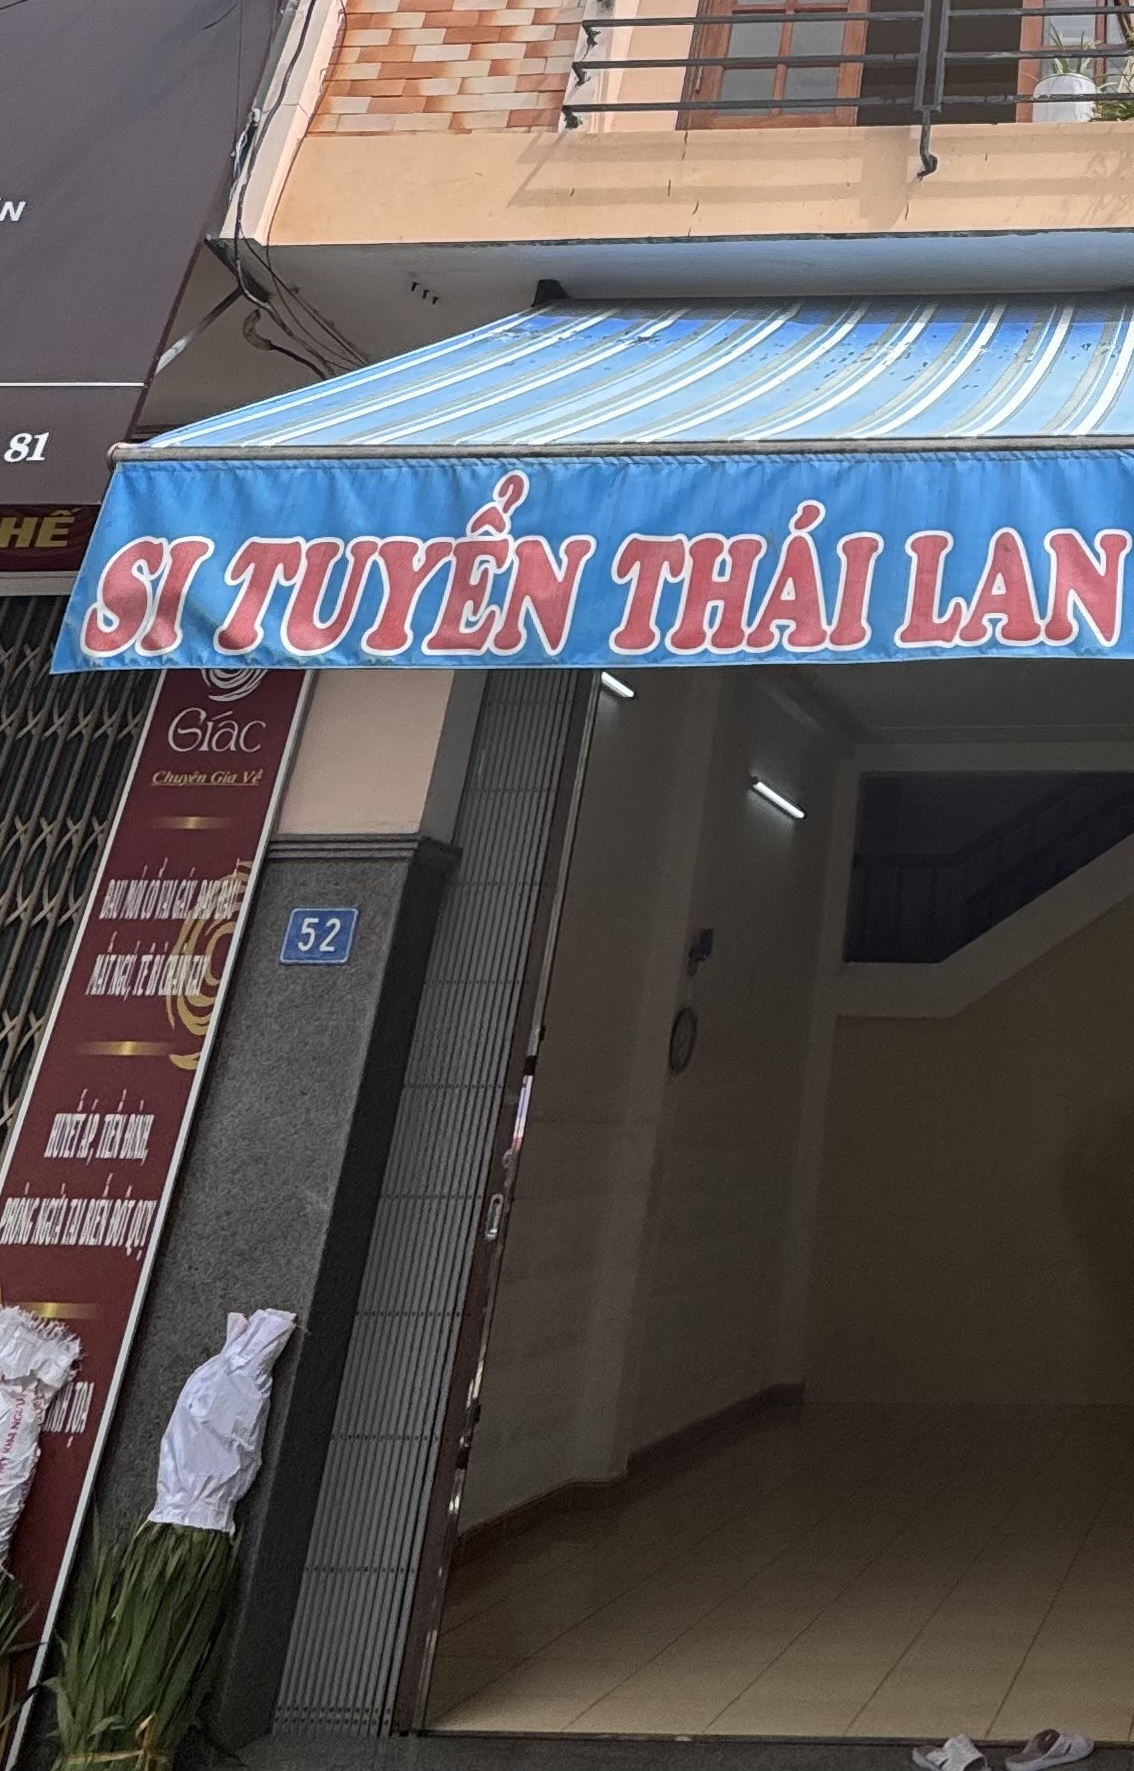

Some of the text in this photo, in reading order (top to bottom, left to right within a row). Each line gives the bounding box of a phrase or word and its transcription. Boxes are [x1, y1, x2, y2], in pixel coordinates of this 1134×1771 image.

[4, 432, 49, 462] 81
[0, 508, 82, 548] HẾ
[80, 470, 1133, 656] SI TUYỂN THÁI LAN
[168, 707, 267, 753] Giác
[152, 770, 208, 786] Chuyên
[210, 770, 239, 785] Gia
[297, 917, 341, 952] 52
